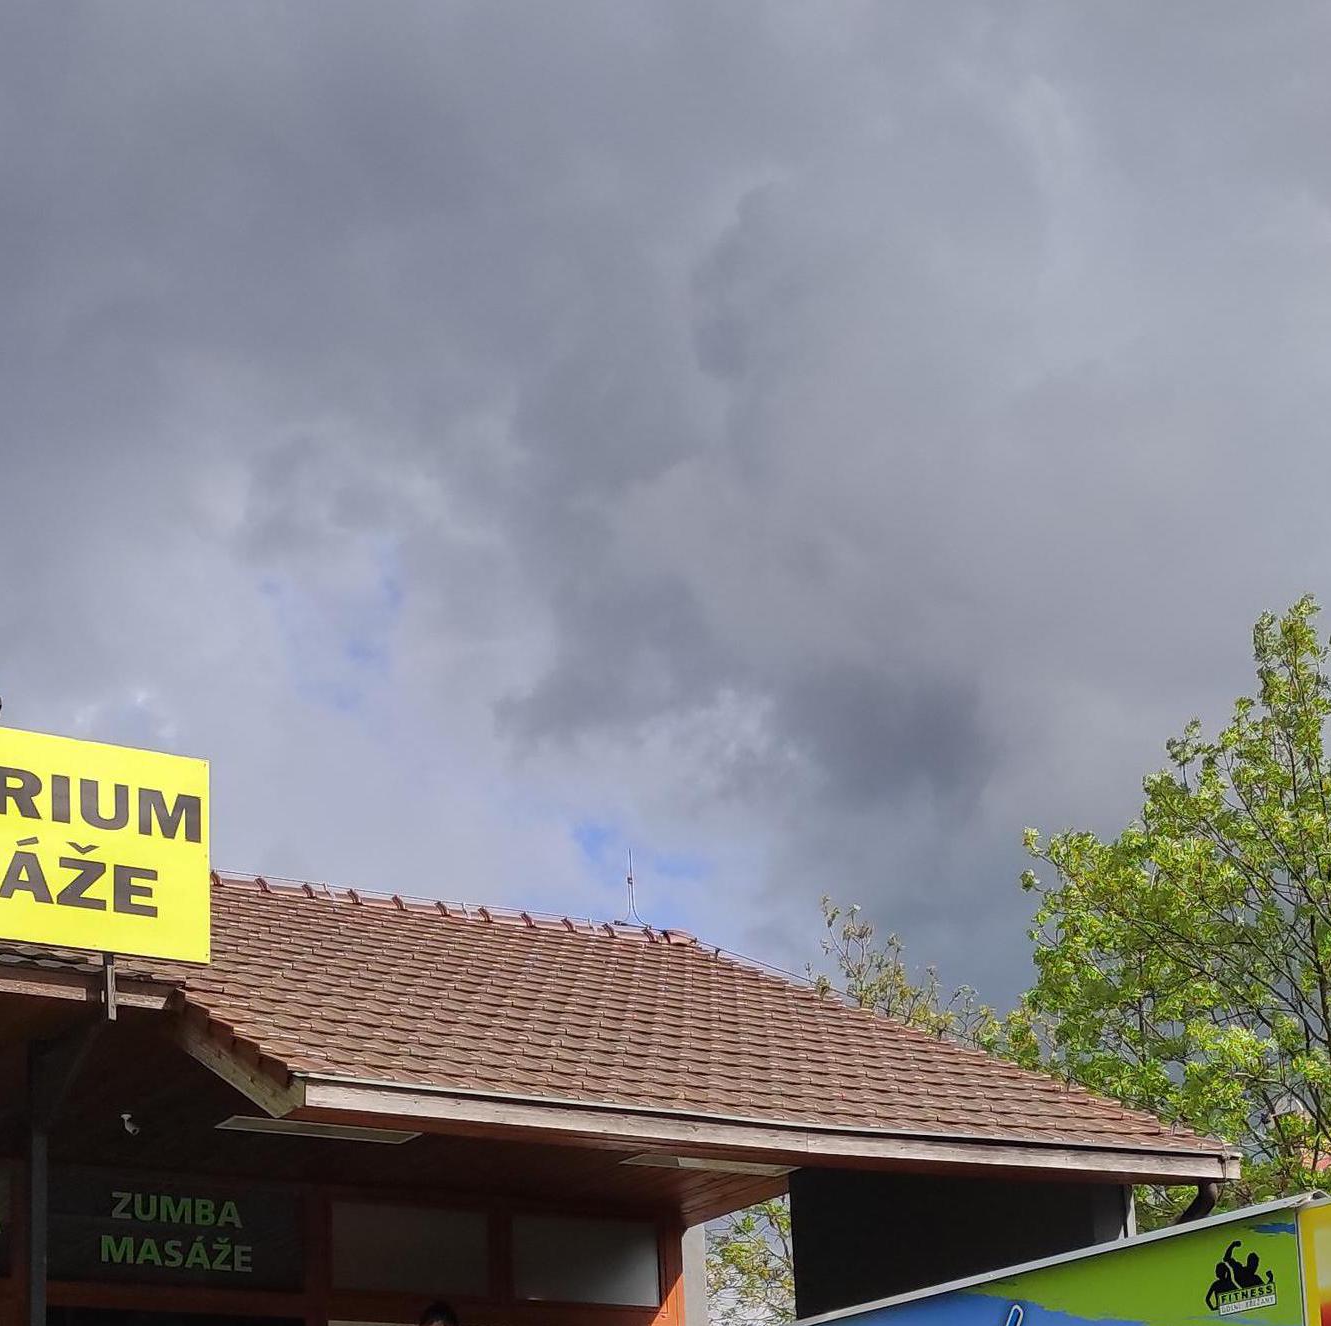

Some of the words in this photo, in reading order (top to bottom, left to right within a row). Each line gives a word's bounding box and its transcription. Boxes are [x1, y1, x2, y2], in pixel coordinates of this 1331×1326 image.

[110, 1191, 243, 1229] ZUMBA
[100, 1234, 254, 1273] MASÁŽE
[1221, 1285, 1273, 1304] FITNESS
